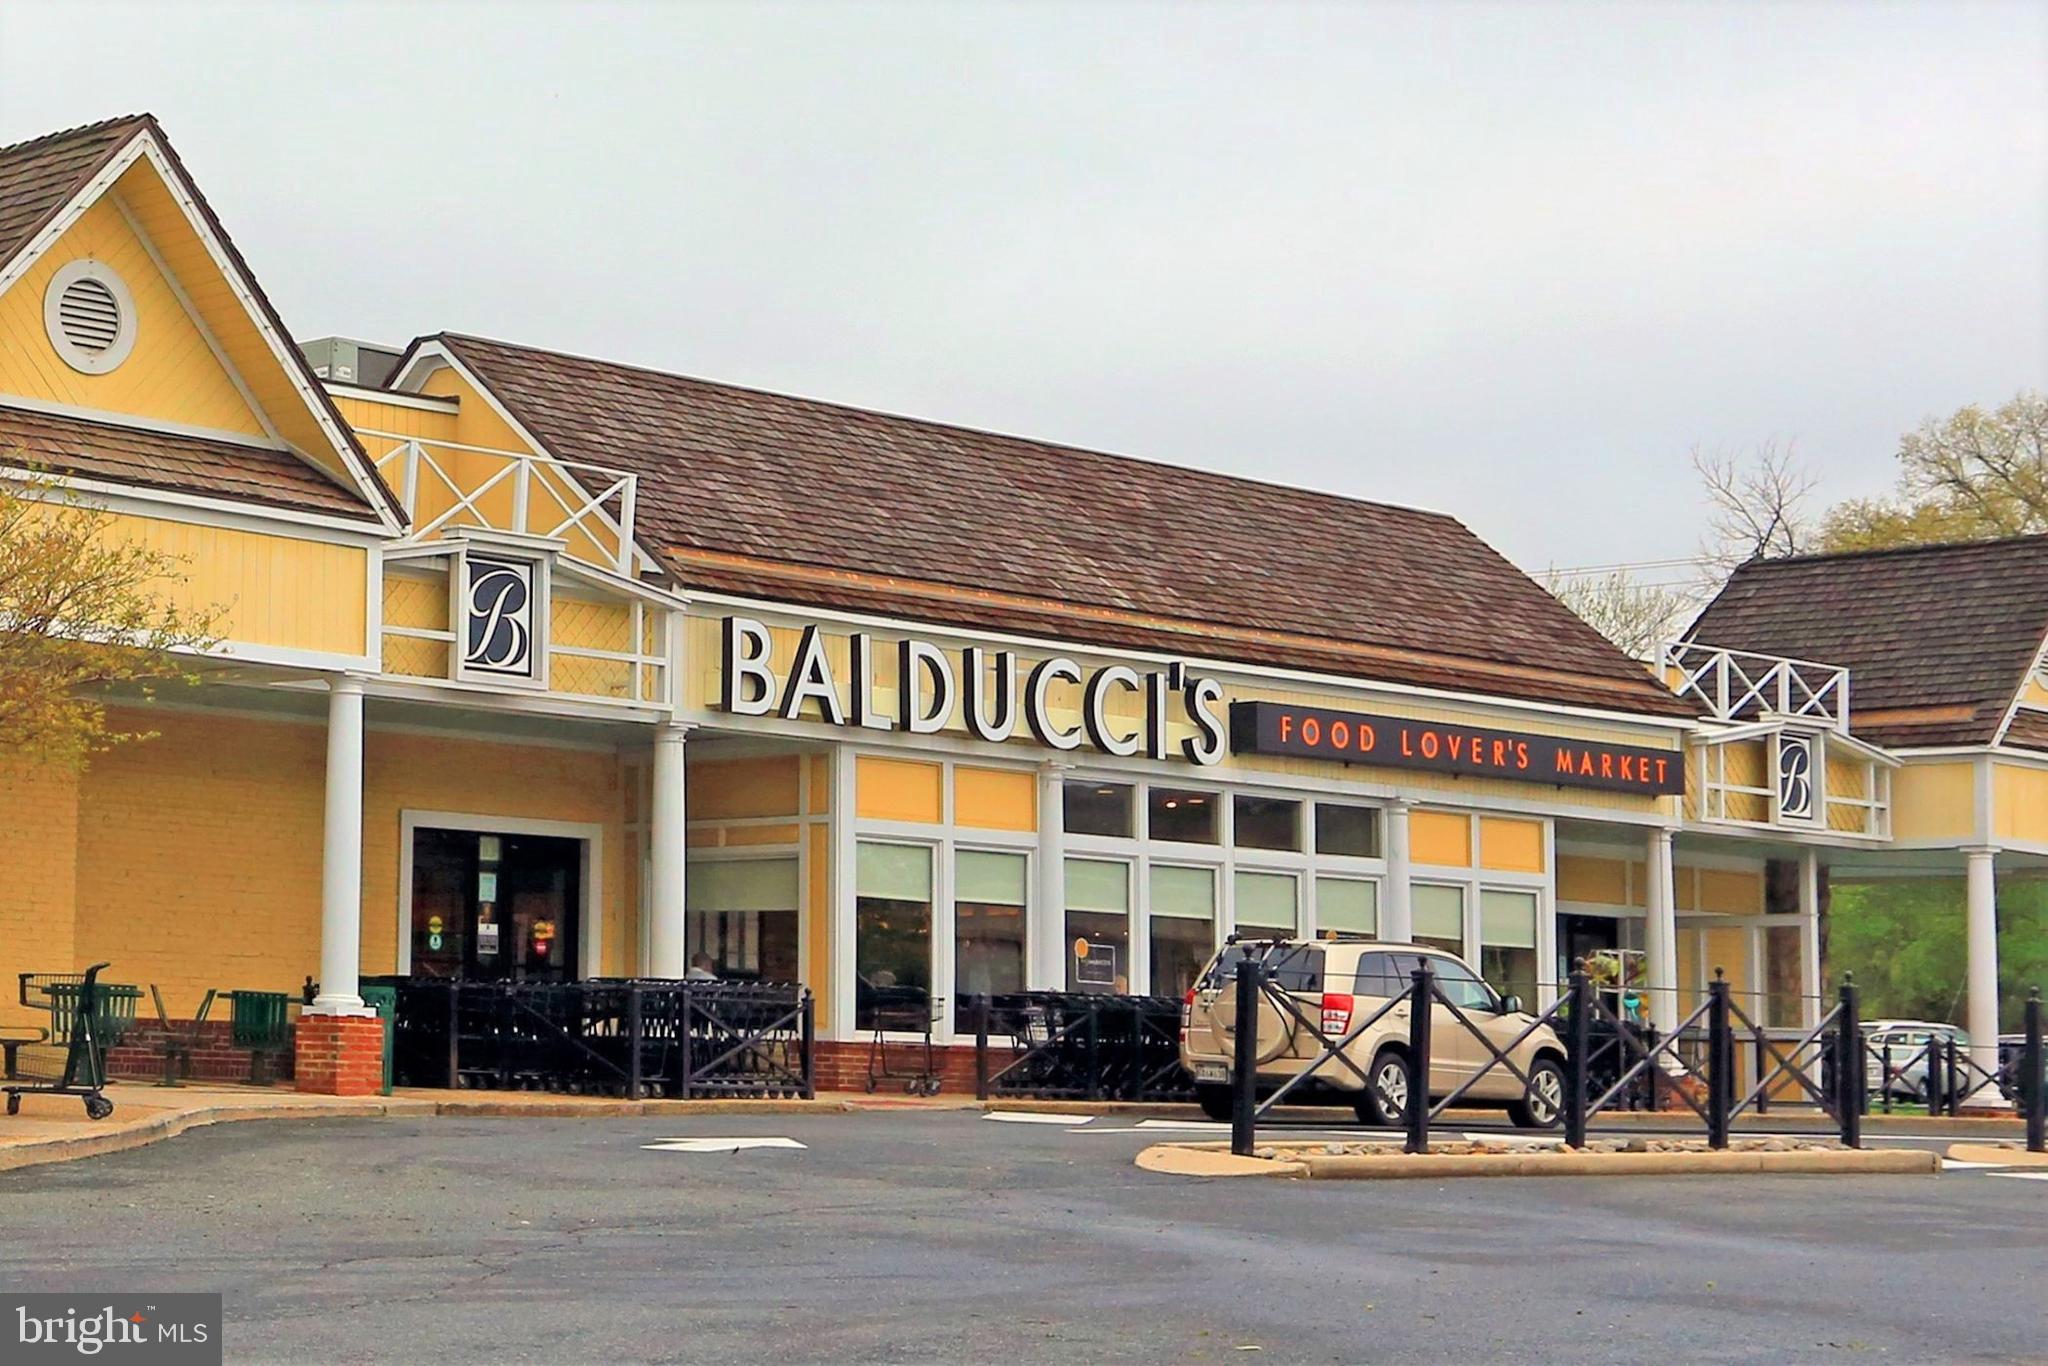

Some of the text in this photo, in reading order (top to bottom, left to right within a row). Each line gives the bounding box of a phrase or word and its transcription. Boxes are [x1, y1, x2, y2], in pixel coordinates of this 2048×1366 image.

[467, 564, 529, 668] B
[721, 615, 1226, 766] BALDUCCI'S
[1280, 715, 1668, 784] FOOD LOVER'S MARKET
[1779, 741, 1810, 815] B
